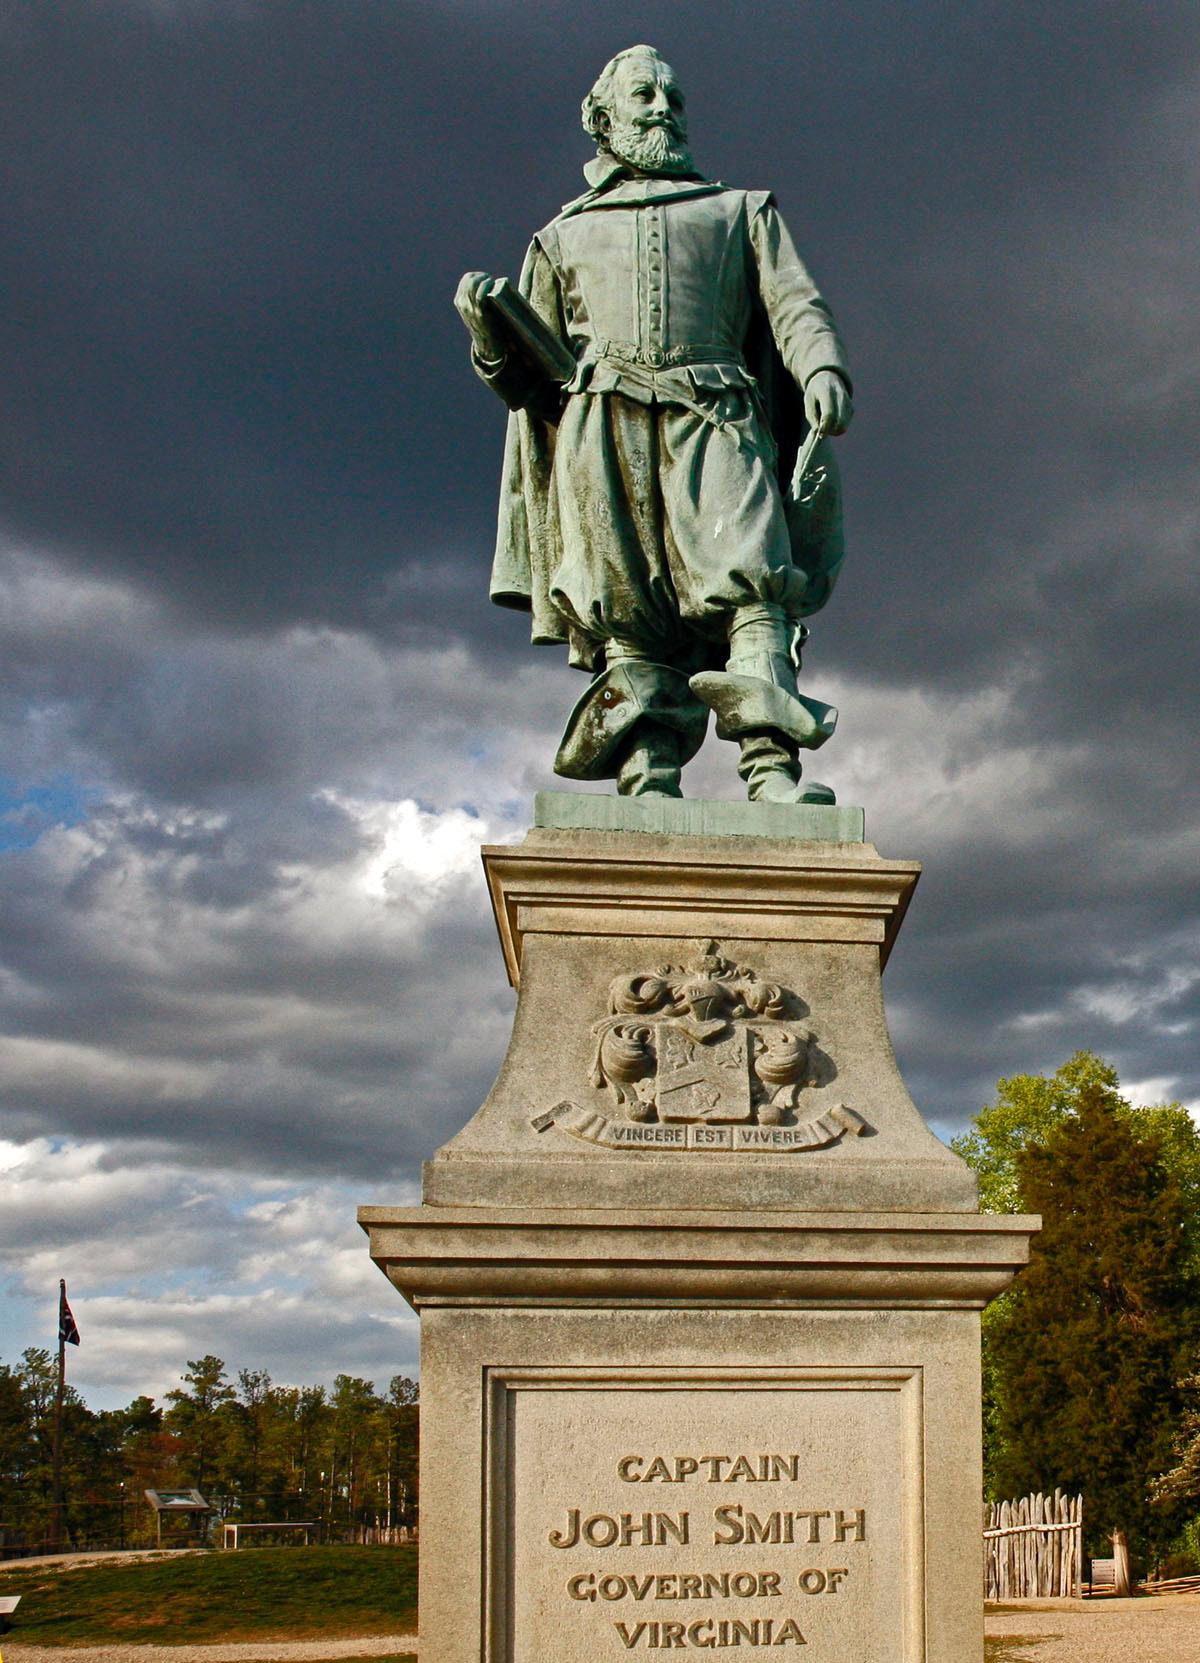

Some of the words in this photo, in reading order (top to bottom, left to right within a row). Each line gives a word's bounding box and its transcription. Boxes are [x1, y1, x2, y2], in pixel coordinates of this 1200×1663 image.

[613, 1127, 683, 1142] VINCERE
[695, 1129, 725, 1144] EST
[741, 1130, 803, 1144] VIVERE
[617, 1454, 800, 1483] CAPTAIN
[548, 1508, 690, 1549] JOHN
[713, 1504, 866, 1544] SMITH
[567, 1572, 782, 1602] GOVERNOR
[797, 1568, 849, 1595] OF
[613, 1618, 808, 1649] VIRGINIA
